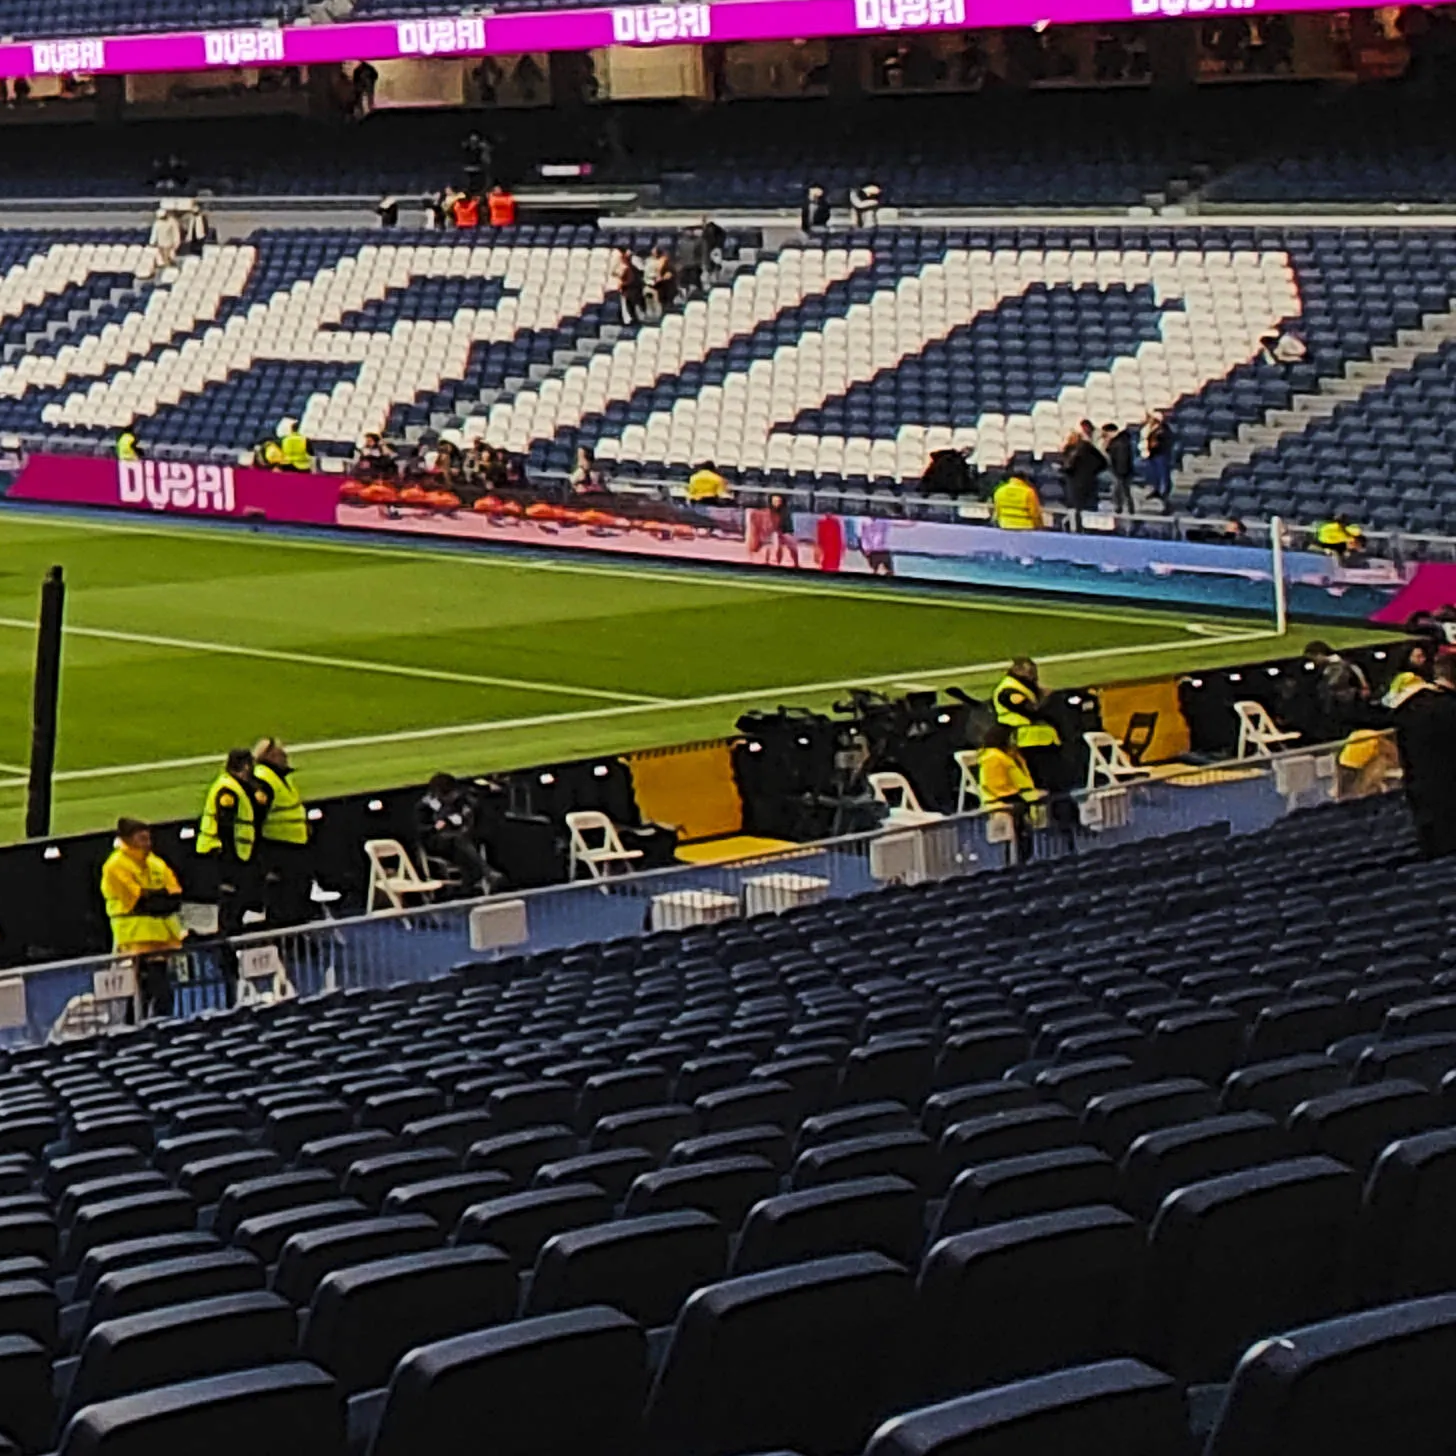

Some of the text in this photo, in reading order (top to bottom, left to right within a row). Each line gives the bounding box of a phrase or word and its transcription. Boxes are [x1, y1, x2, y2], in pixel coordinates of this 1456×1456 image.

[397, 17, 486, 55] DUBAI
[612, 4, 711, 43] DUBAI
[33, 39, 104, 74] DUBAI
[205, 28, 284, 65] DUBAI
[118, 459, 236, 511] DUBAI
